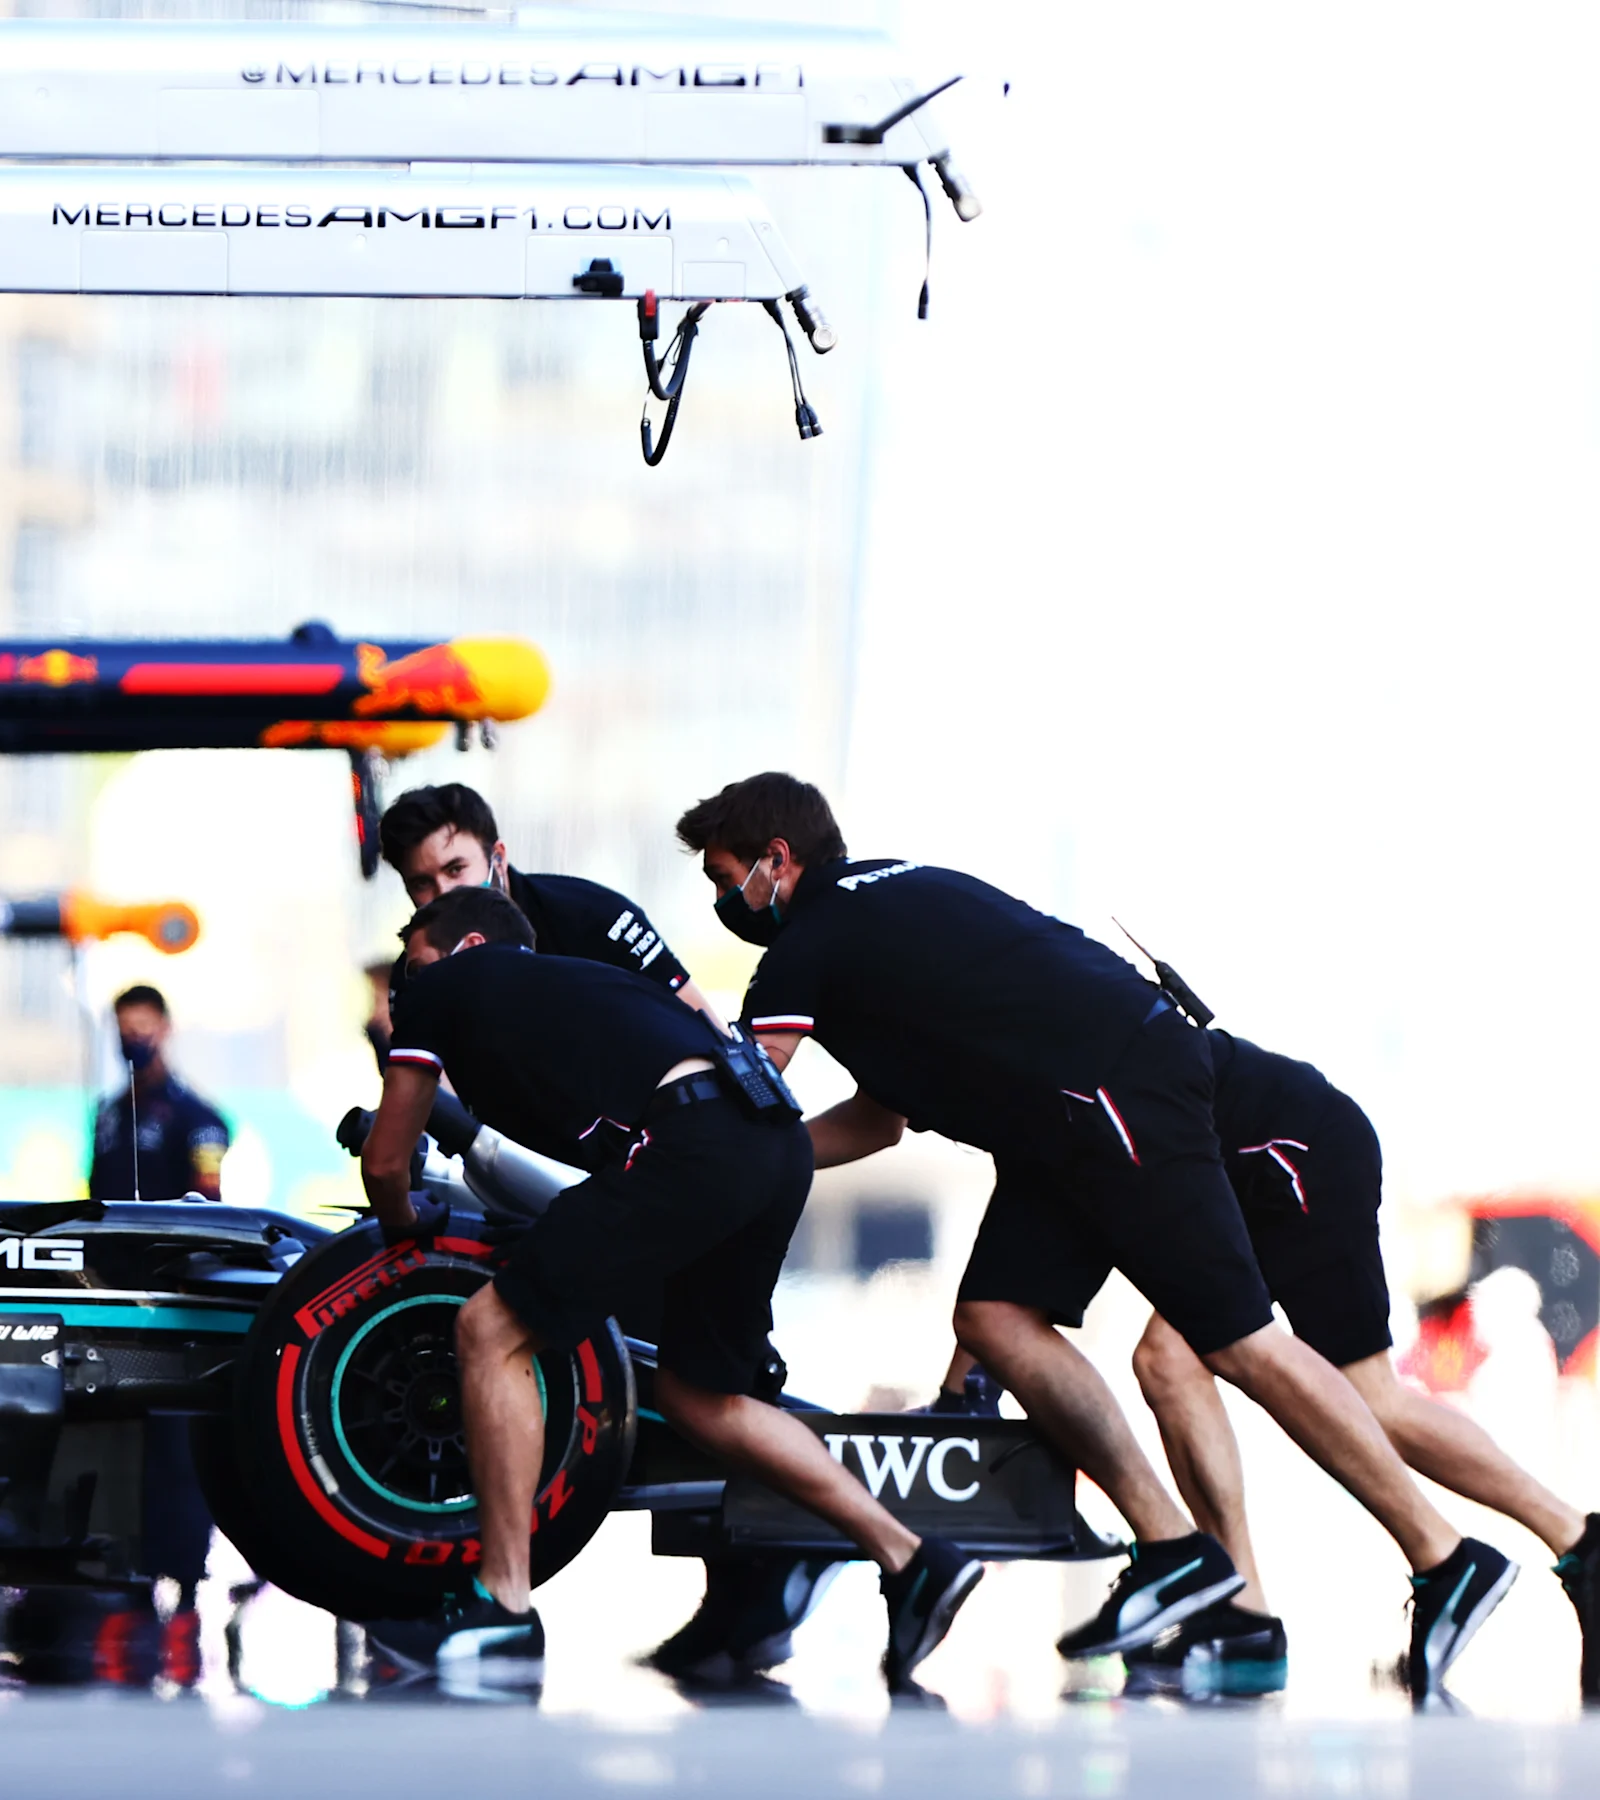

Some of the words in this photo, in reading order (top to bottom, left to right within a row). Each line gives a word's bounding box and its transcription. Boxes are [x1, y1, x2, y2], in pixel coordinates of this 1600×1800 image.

[51, 203, 672, 230] MERCEDESAMGF1.COM
[607, 909, 634, 942] EPSON
[623, 921, 643, 944] IWC
[629, 930, 656, 957] TIBCO
[293, 1238, 428, 1339] PIRELLI
